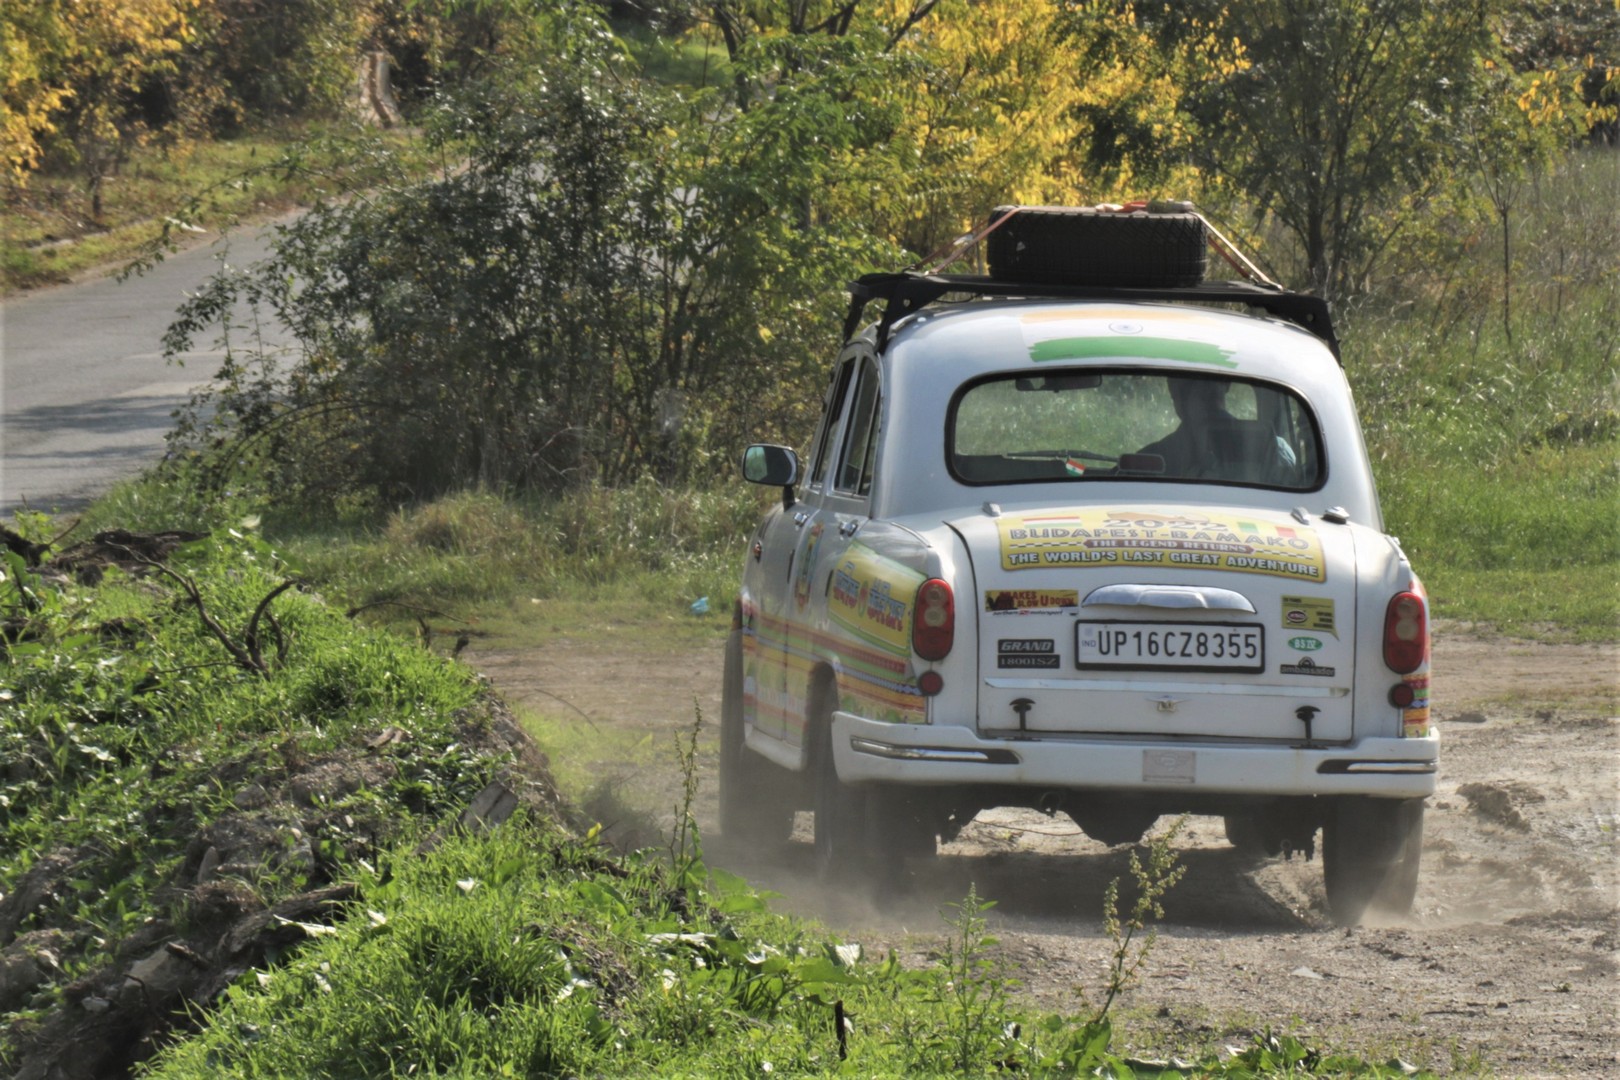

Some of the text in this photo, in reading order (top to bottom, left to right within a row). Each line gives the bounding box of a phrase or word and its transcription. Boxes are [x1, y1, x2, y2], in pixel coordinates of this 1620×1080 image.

[1103, 518, 1228, 532] 2022
[1009, 527, 1310, 550] BUDAPEST-BAMAKO
[1091, 539, 1247, 553] THE LEGEND RETURNS
[1008, 551, 1319, 577] THE WORLD'S LAST GREAT ADVENTURE
[1001, 641, 1052, 651] GRAND
[1081, 630, 1257, 659] IND UP16CZ8355
